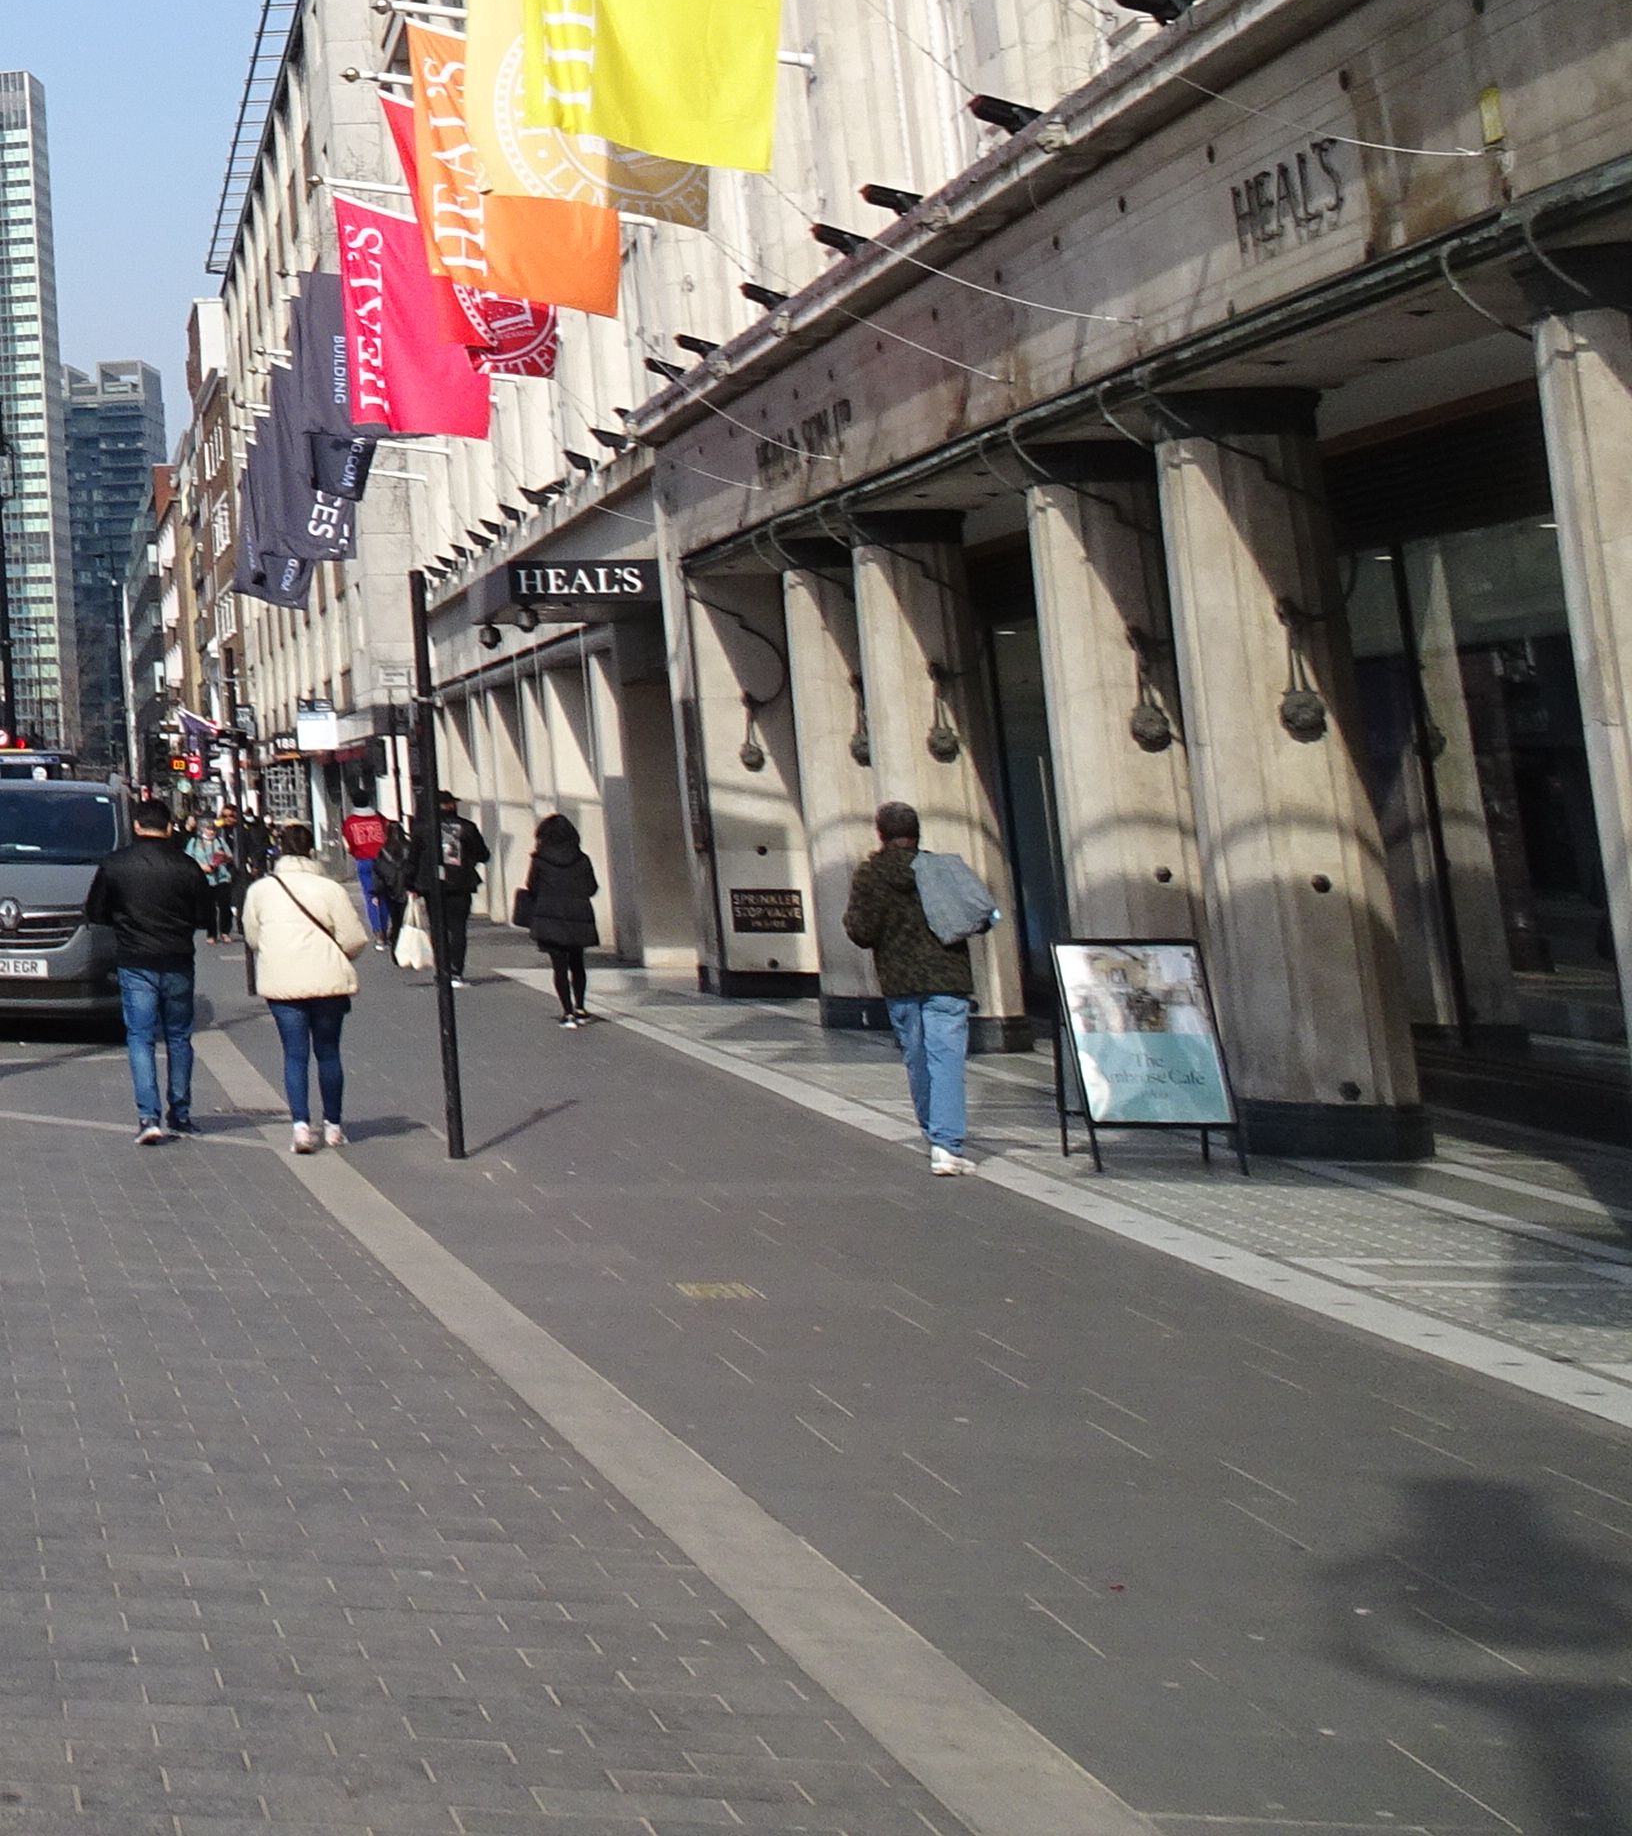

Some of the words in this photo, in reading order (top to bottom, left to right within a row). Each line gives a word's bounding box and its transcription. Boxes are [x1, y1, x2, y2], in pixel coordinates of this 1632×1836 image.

[1230, 138, 1344, 256] HEAL'S
[344, 225, 390, 414] HEAL'S
[333, 335, 347, 404] BUILDING
[517, 567, 643, 595] HEAL'S
[732, 893, 801, 905] SPRINKLER
[733, 907, 764, 918] STOP
[765, 906, 802, 920] VALVE
[13, 960, 39, 973] EGR
